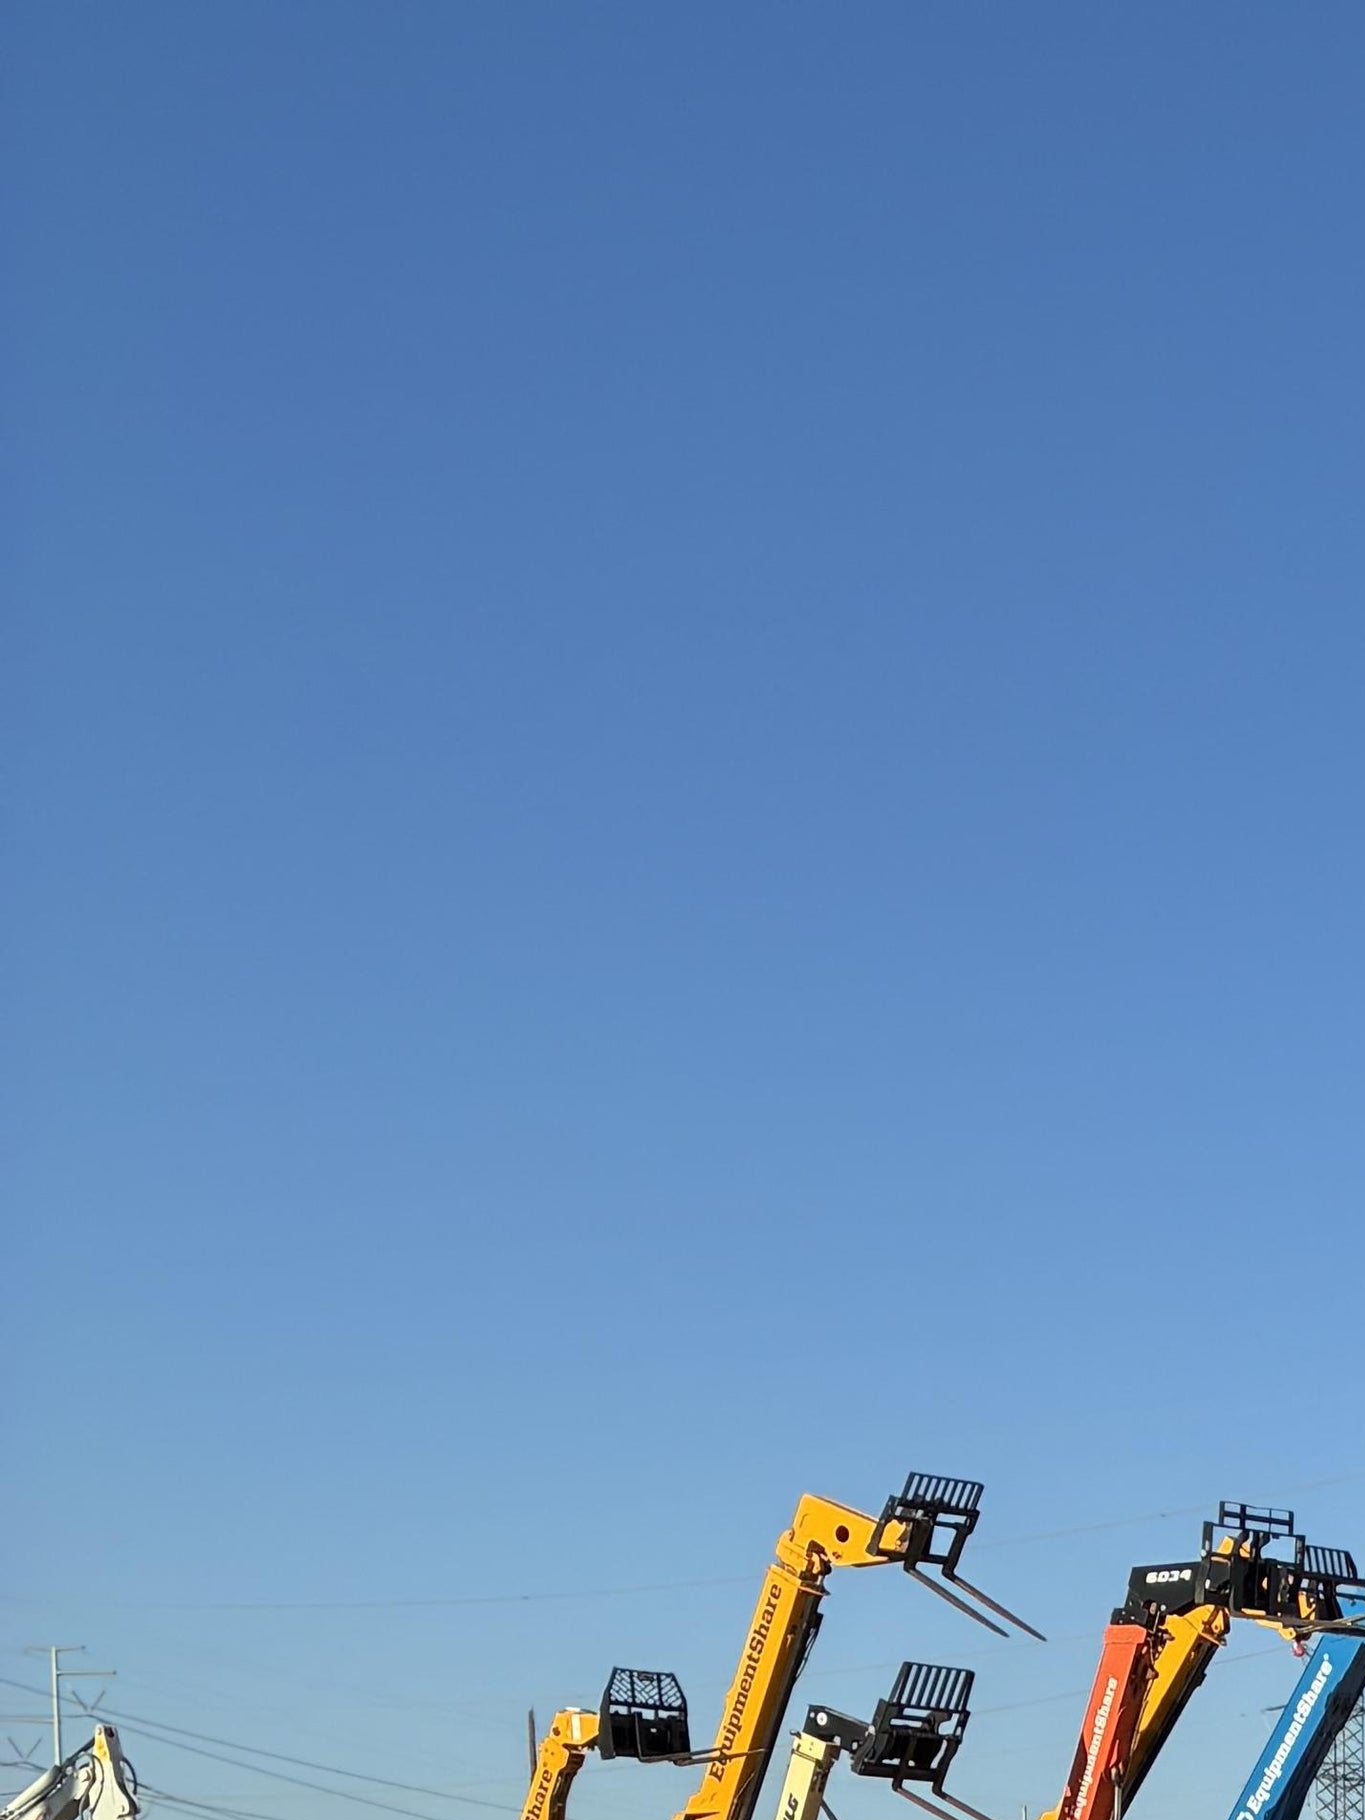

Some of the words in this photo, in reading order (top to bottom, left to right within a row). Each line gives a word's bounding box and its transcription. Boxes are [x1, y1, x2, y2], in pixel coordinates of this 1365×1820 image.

[1146, 1569, 1191, 1583] 6034
[709, 1583, 782, 1783] EquipmentShare
[1246, 1661, 1332, 1815] EquipmentShare
